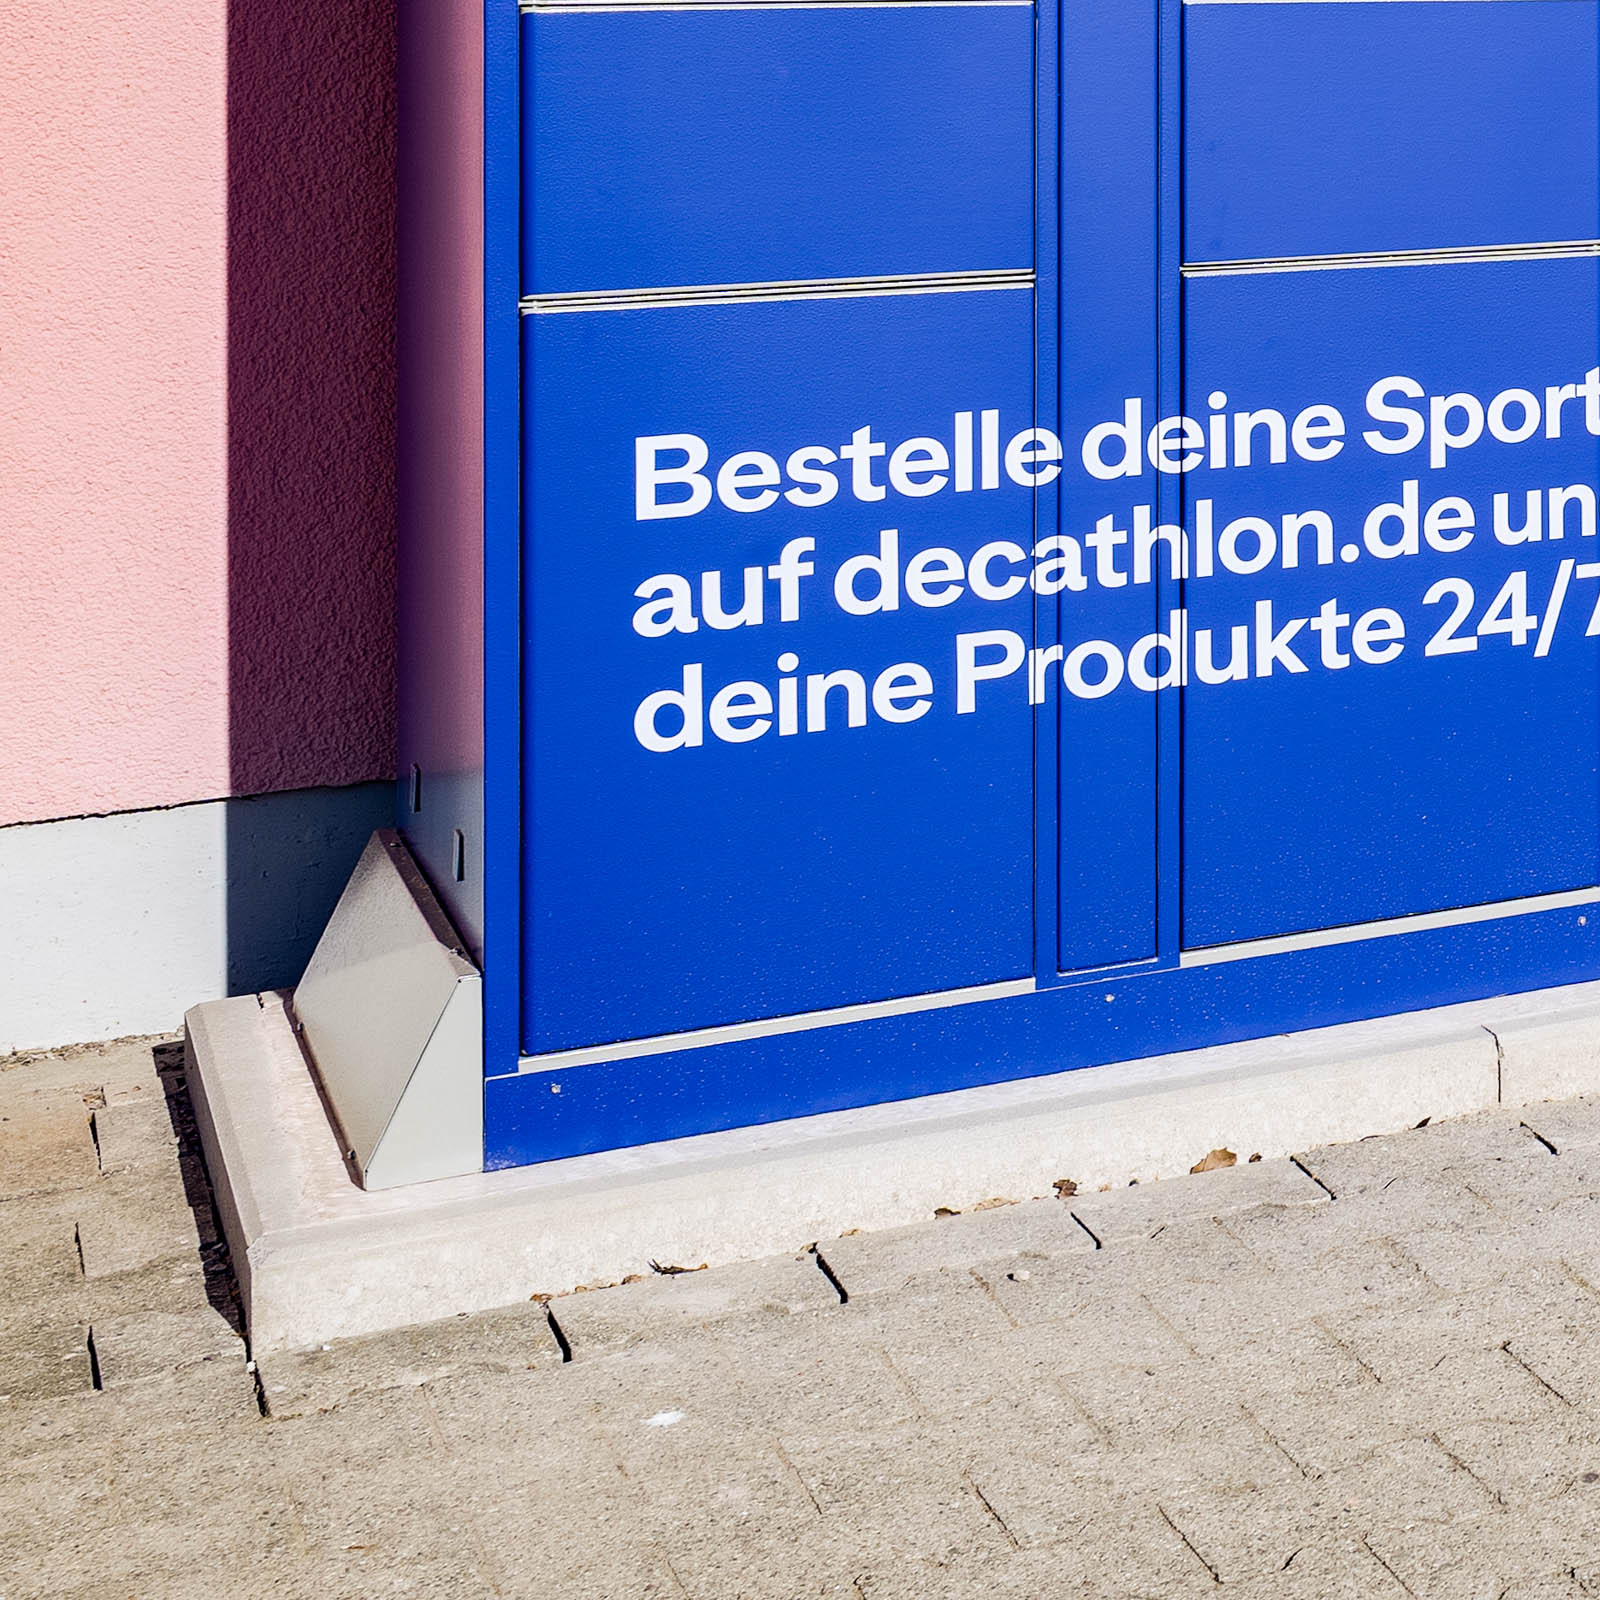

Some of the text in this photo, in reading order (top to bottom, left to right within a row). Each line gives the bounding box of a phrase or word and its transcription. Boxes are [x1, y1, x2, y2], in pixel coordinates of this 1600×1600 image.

[635, 409, 1063, 521] Bestelle
[1081, 391, 1345, 480] deine
[632, 536, 815, 638] auf
[833, 479, 1475, 616] decathlon.de
[633, 652, 933, 753] deine
[955, 598, 1406, 715] Produkte
